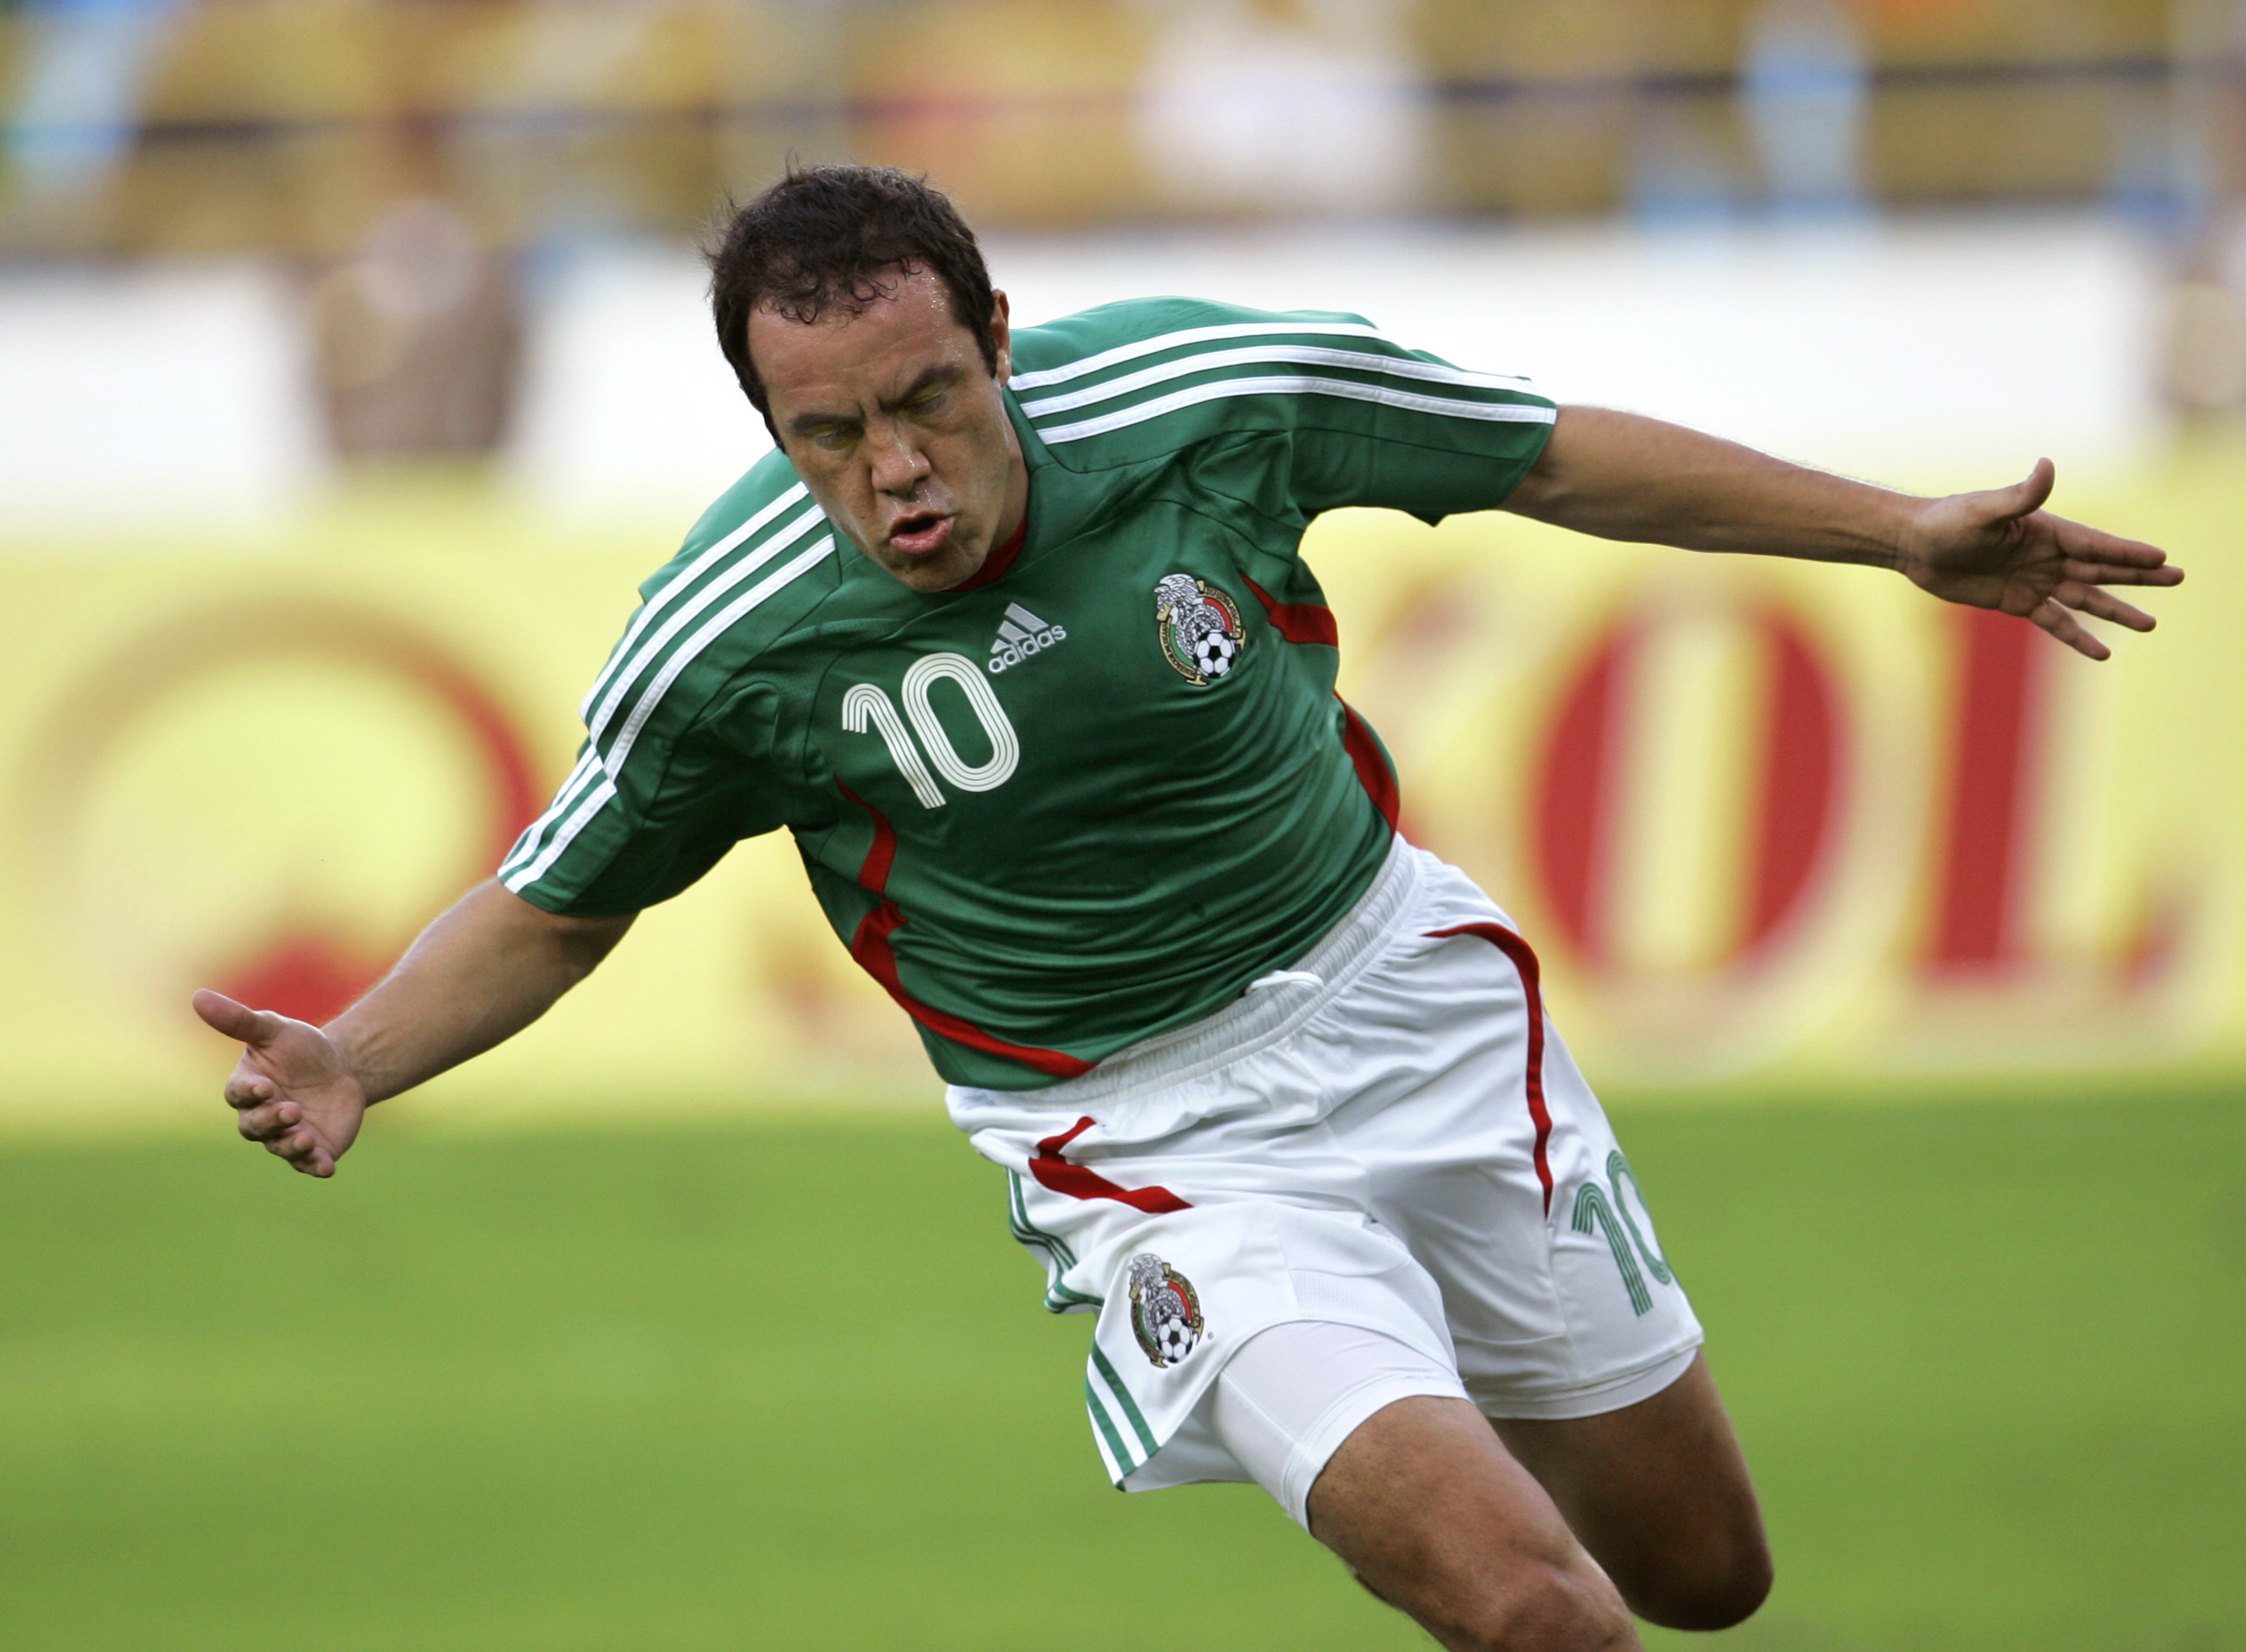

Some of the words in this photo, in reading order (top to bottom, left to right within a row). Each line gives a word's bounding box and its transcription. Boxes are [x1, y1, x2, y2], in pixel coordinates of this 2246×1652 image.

[988, 625, 1067, 674] adidas
[841, 652, 1021, 810] 10
[1571, 1149, 1673, 1318] 10
